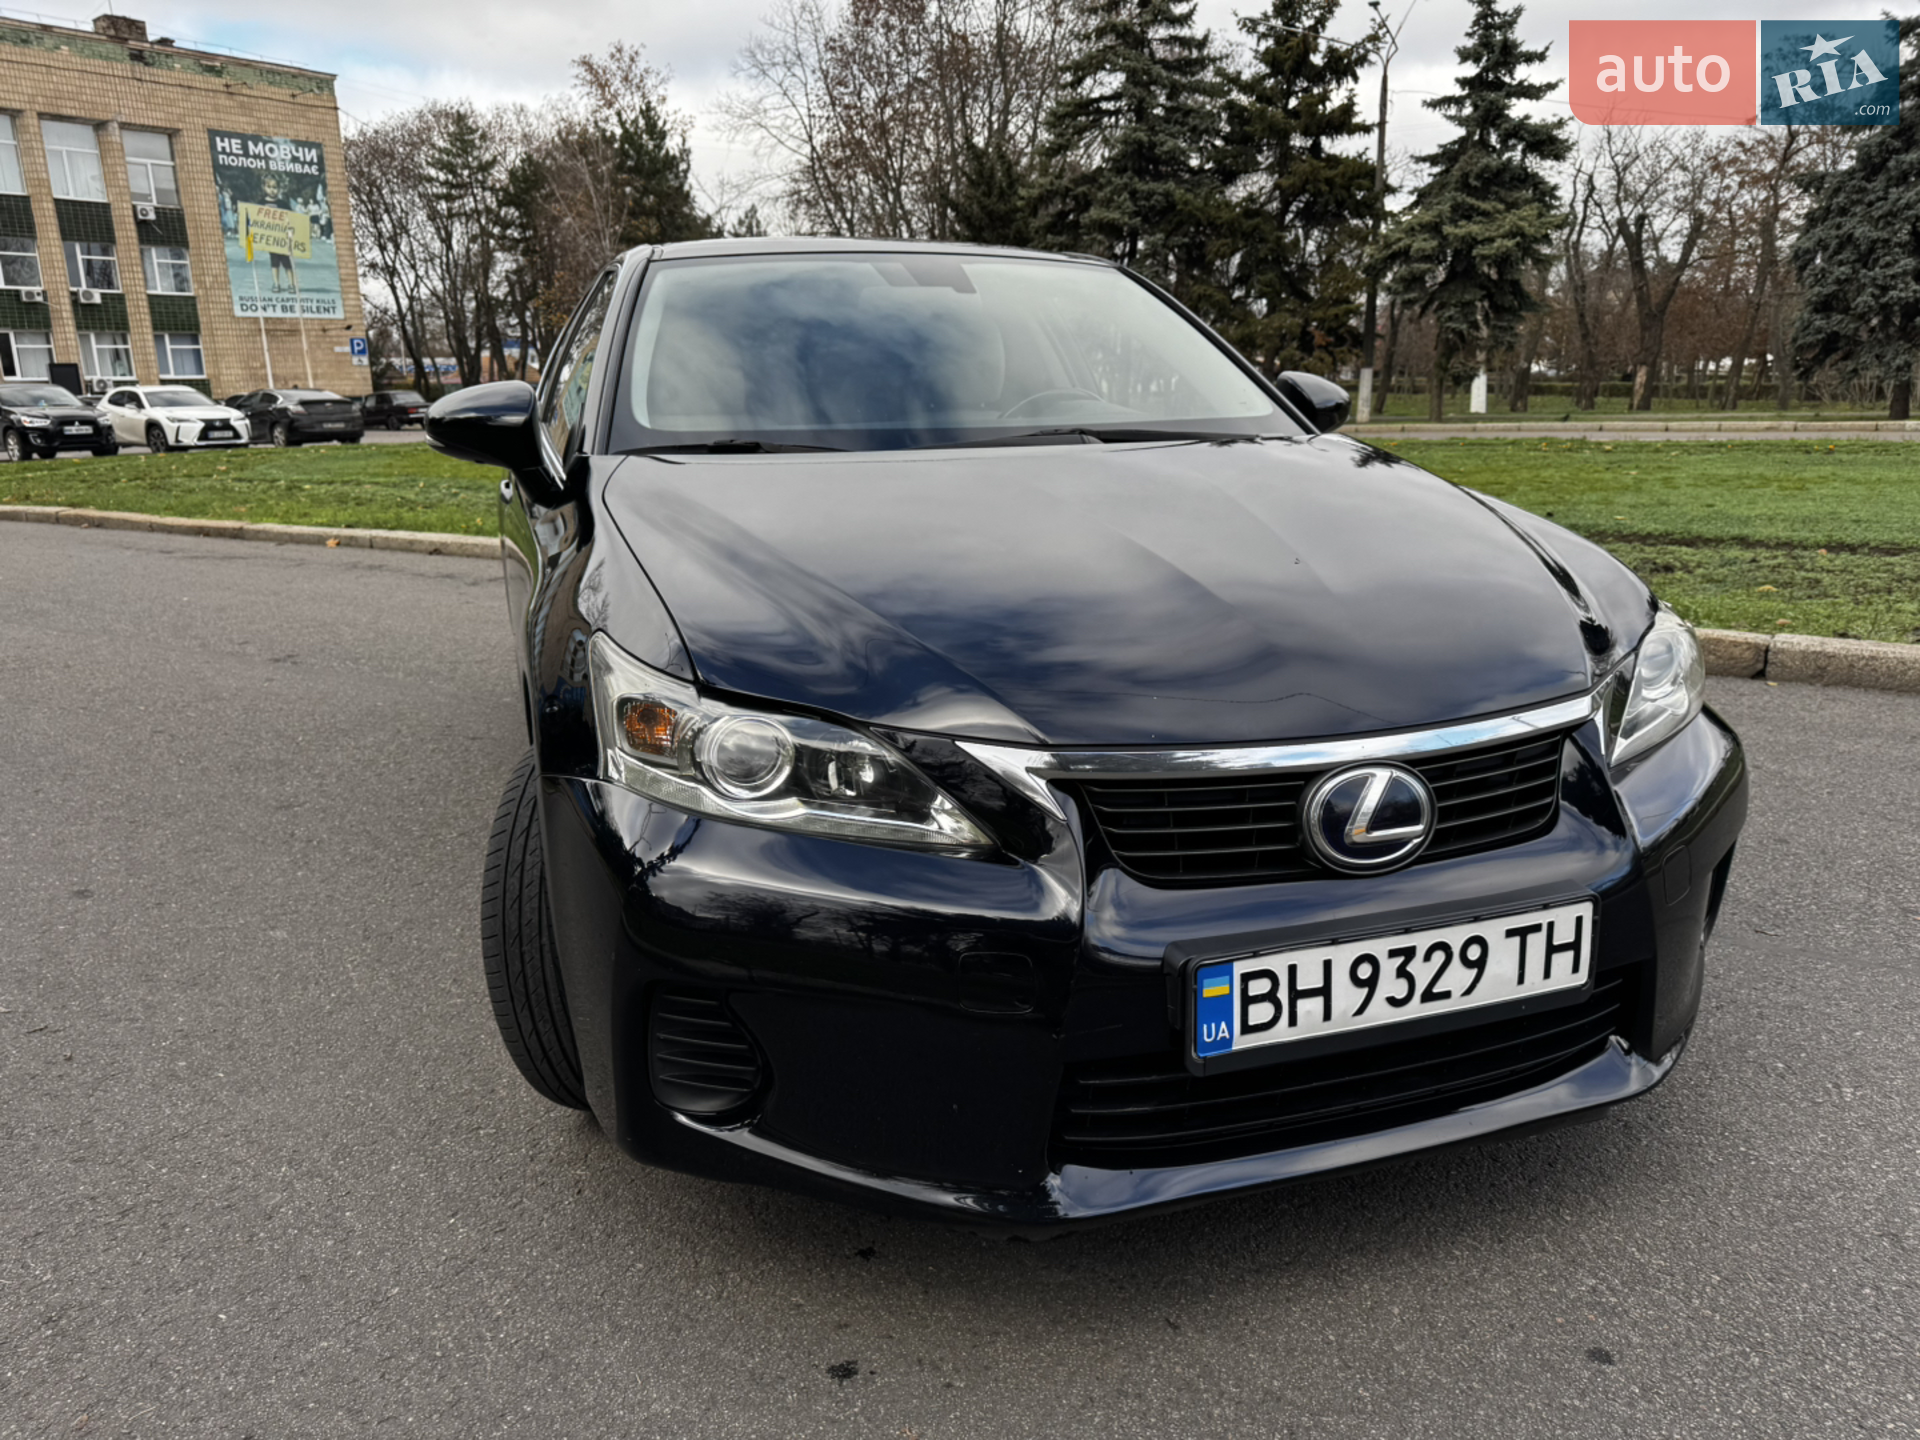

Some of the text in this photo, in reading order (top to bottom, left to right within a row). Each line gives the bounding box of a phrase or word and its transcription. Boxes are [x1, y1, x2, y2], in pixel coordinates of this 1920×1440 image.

[215, 136, 318, 163] НЕ МОВЧИ
[218, 154, 320, 175] ПОЛОН ВБИВАЄ
[257, 207, 288, 222] FREE
[253, 232, 306, 253] EFENDRS
[240, 303, 337, 314] DON'T BE SILENT
[275, 296, 314, 304] CAPTIITY
[353, 339, 365, 354] P
[1239, 914, 1584, 1036] BH 9329 TH
[1202, 1021, 1230, 1043] UA
